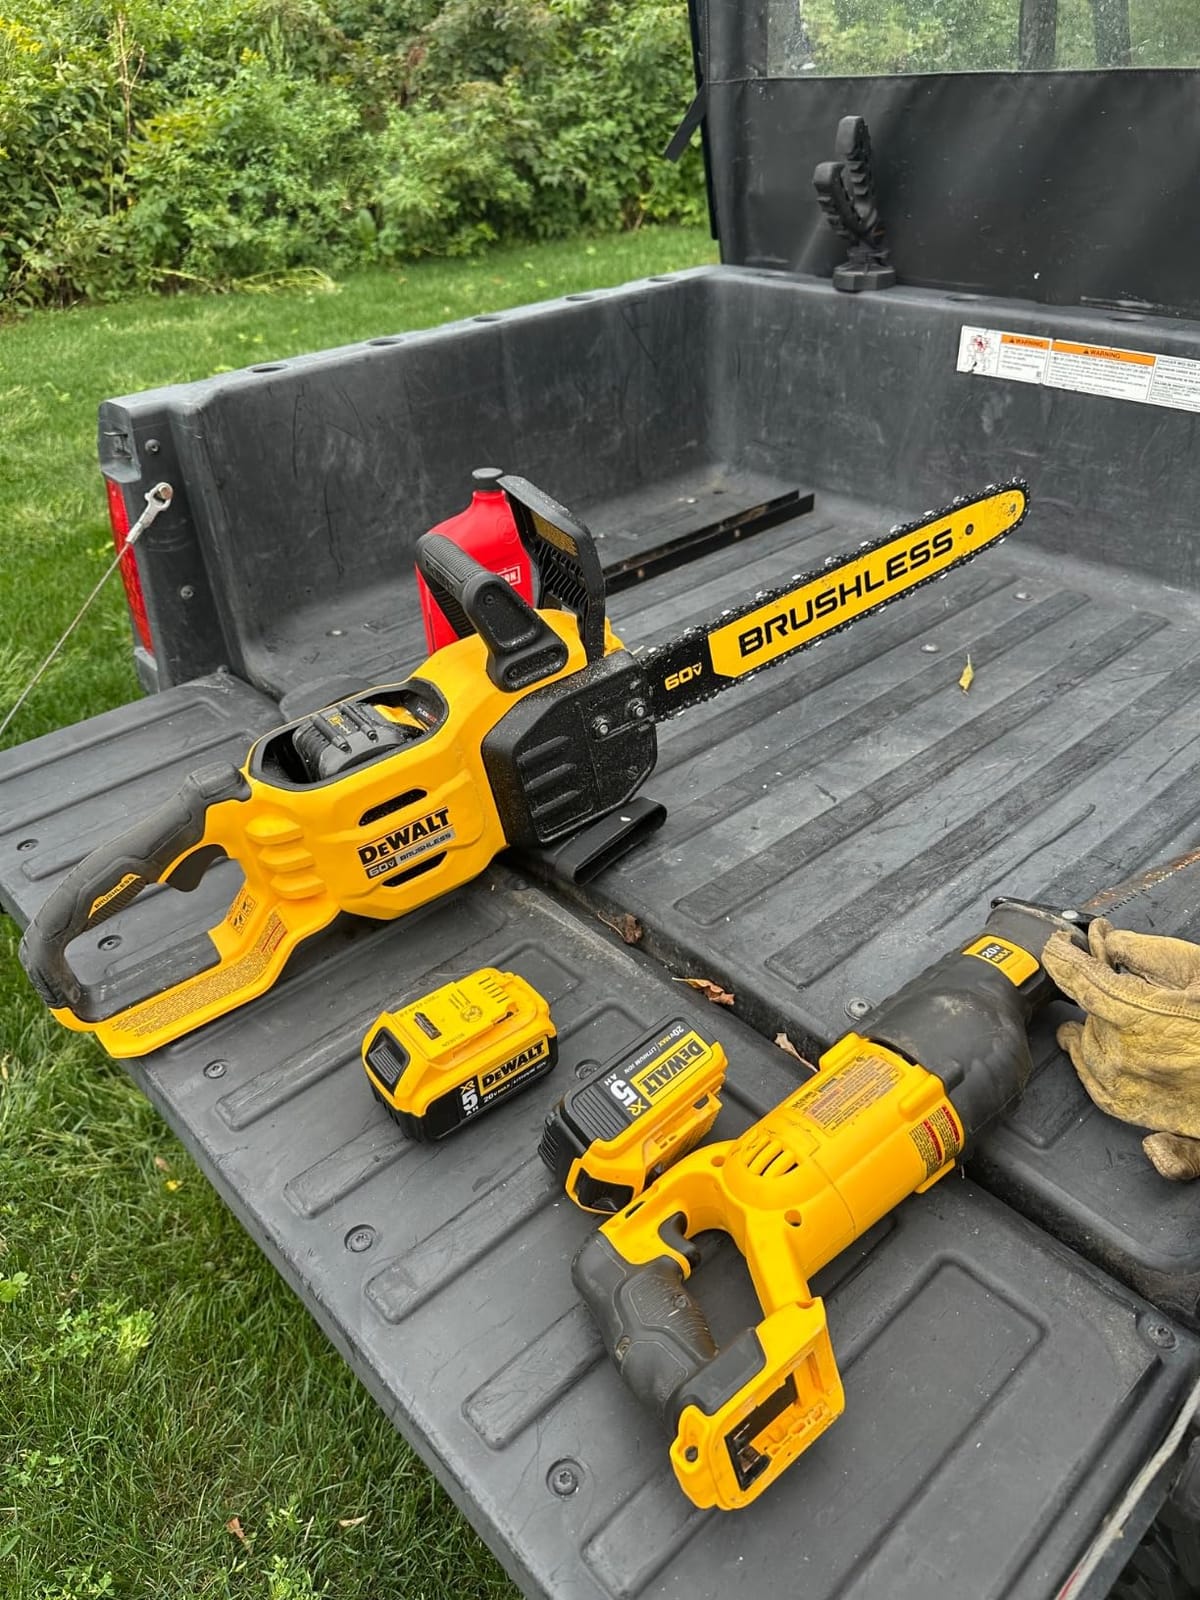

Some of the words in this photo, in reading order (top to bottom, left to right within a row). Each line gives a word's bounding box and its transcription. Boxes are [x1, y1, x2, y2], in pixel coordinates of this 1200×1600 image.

[1090, 346, 1120, 359] WARNING
[738, 528, 953, 658] BRUSHLESS
[399, 832, 452, 862] BRUSHLESS
[94, 876, 135, 909] BRUSHLESS
[991, 949, 1011, 962] MAX
[658, 1035, 671, 1047] MAX
[634, 1046, 657, 1066] LITHIUM
[624, 1063, 635, 1074] ION
[460, 1080, 476, 1095] XR
[610, 1079, 638, 1107] 5
[461, 1089, 478, 1111] 5
[627, 1098, 647, 1116] XR
